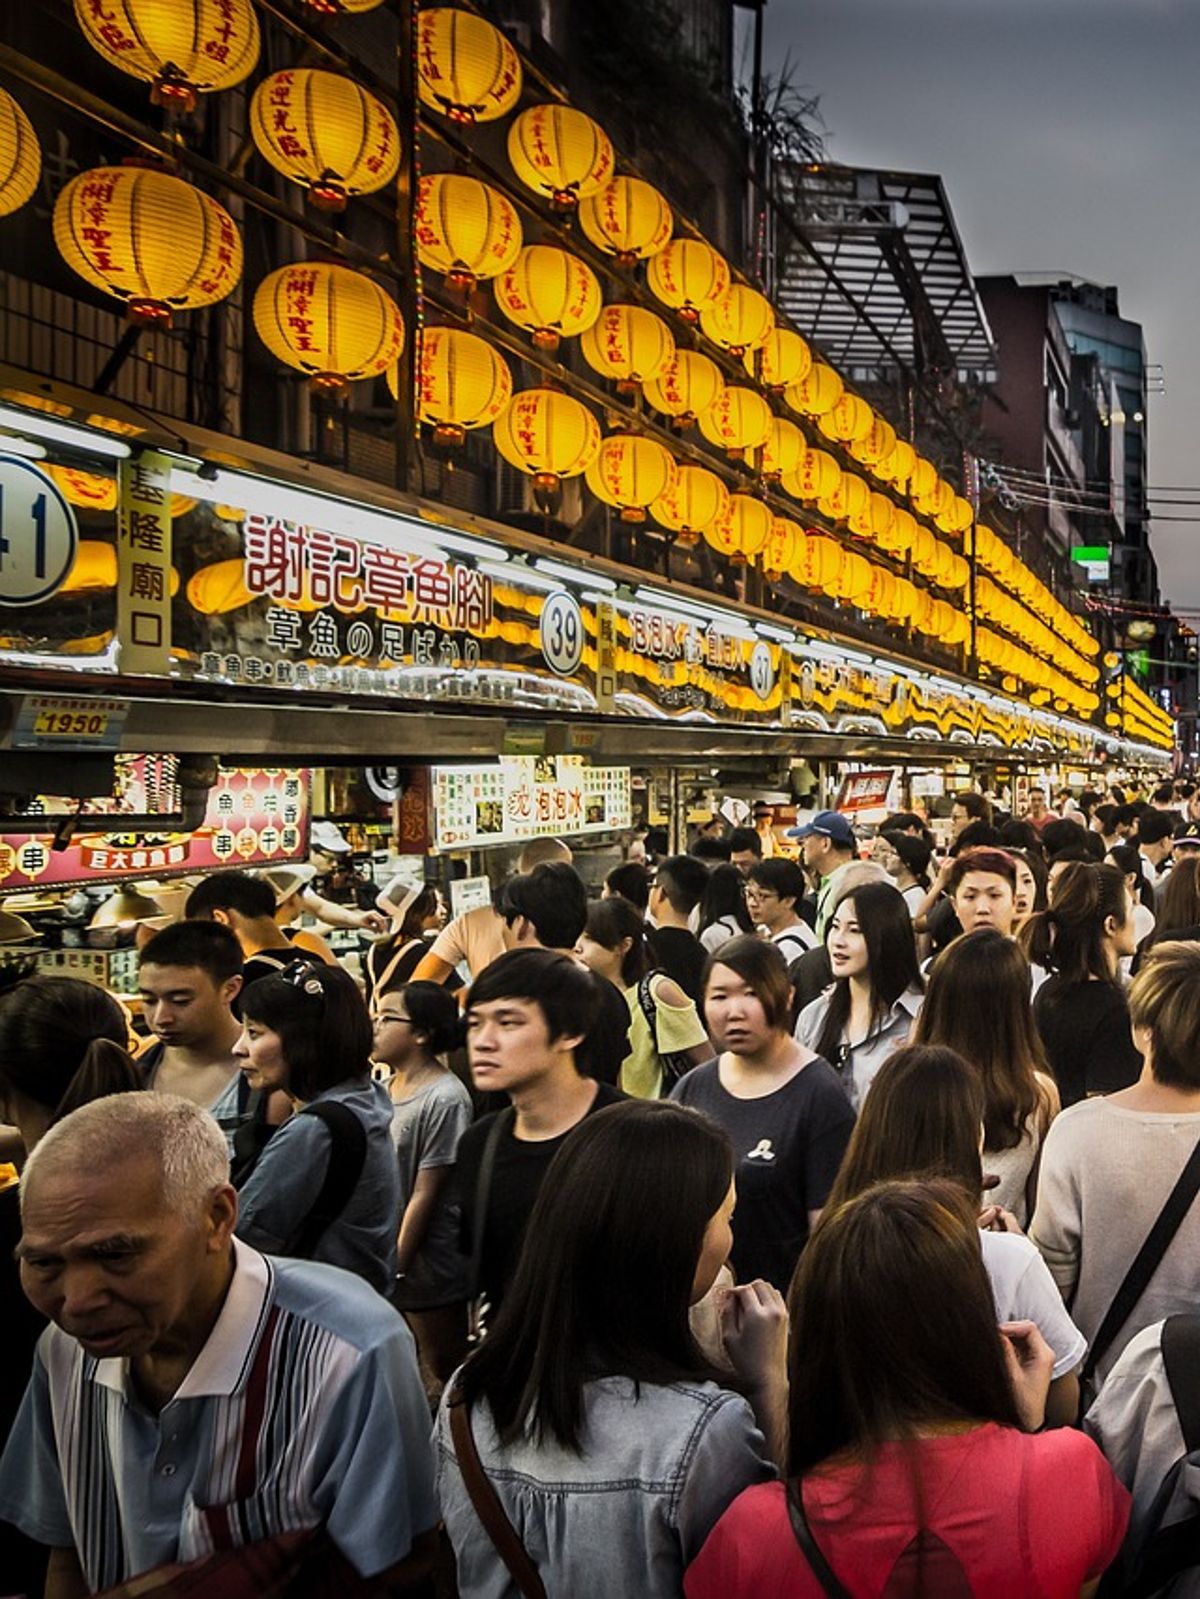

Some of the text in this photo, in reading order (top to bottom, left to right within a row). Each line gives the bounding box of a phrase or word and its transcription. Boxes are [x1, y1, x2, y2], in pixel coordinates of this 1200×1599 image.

[130, 463, 164, 648] 基隆廟口
[246, 513, 494, 633] 謝記章魚腳
[266, 607, 482, 672] 章魚の足ばかり
[550, 614, 578, 660] 39
[43, 711, 102, 734] 1950
